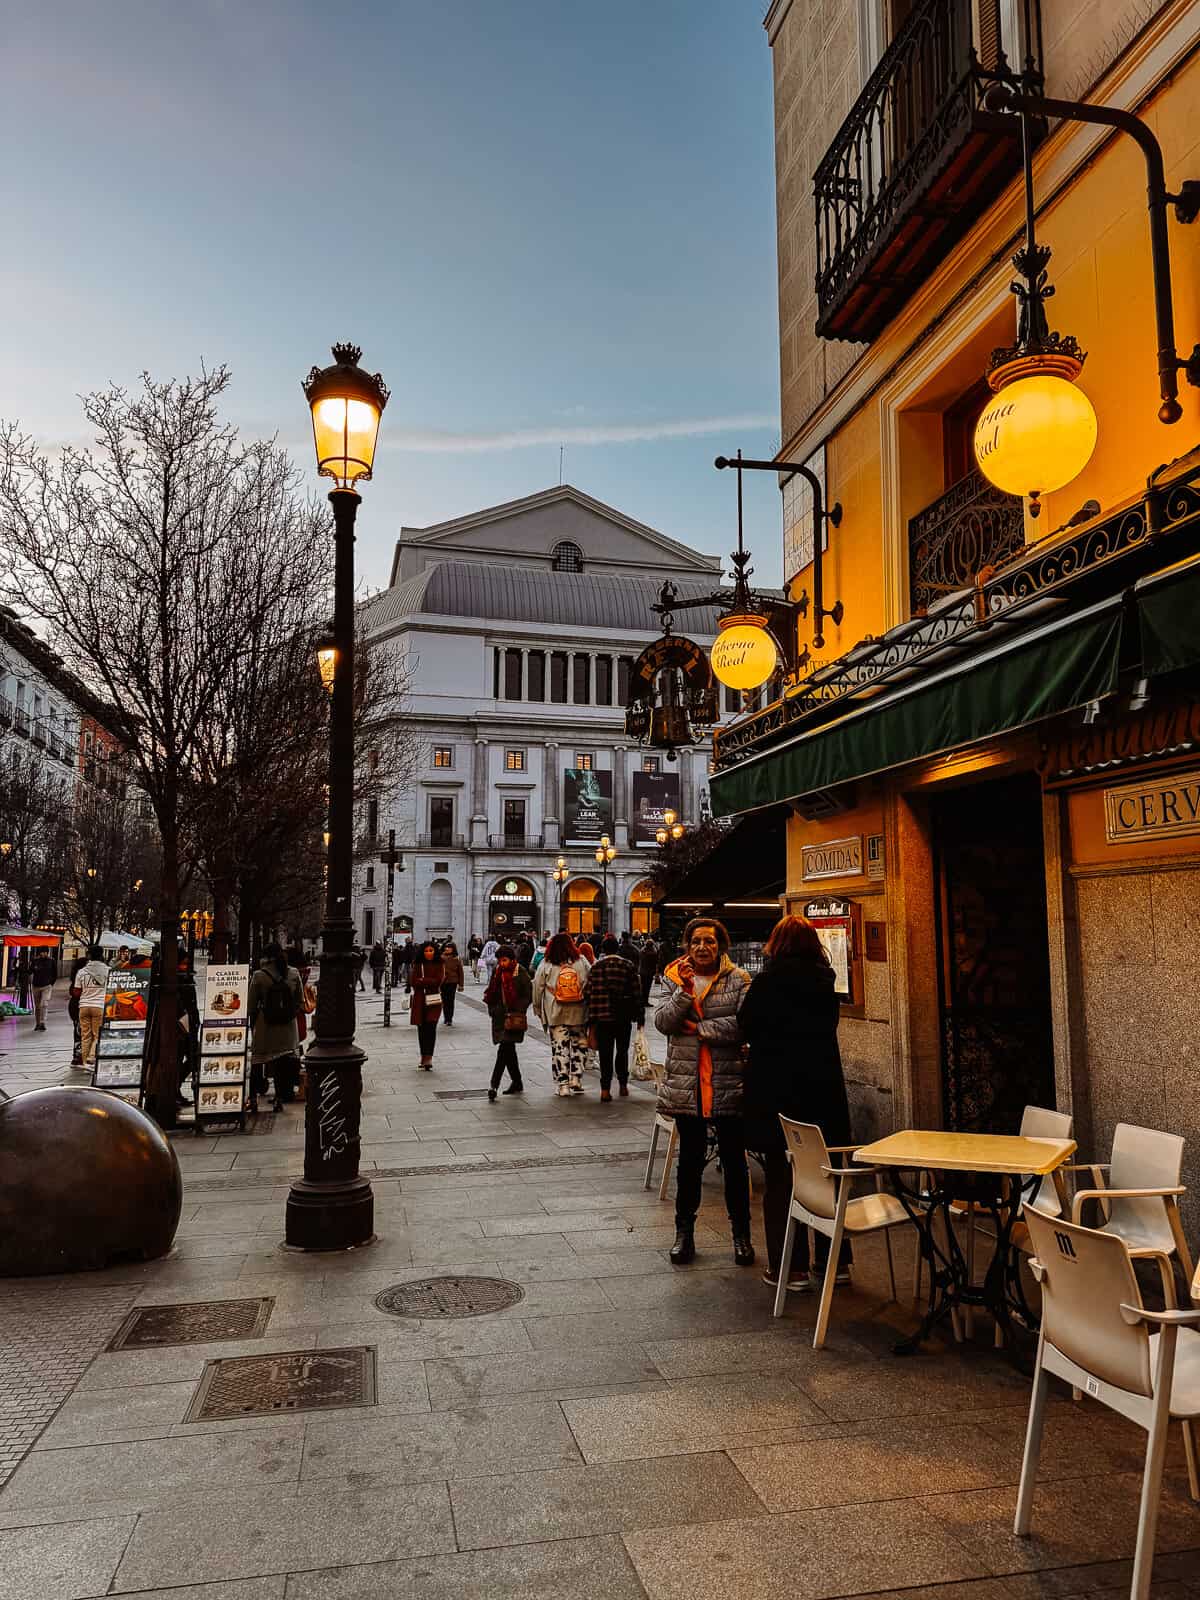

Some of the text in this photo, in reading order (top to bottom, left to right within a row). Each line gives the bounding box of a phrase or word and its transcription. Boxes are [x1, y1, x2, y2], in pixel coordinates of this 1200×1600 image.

[716, 650, 746, 669] Real
[808, 847, 859, 872] COMIDAS
[119, 980, 149, 989] vida?
